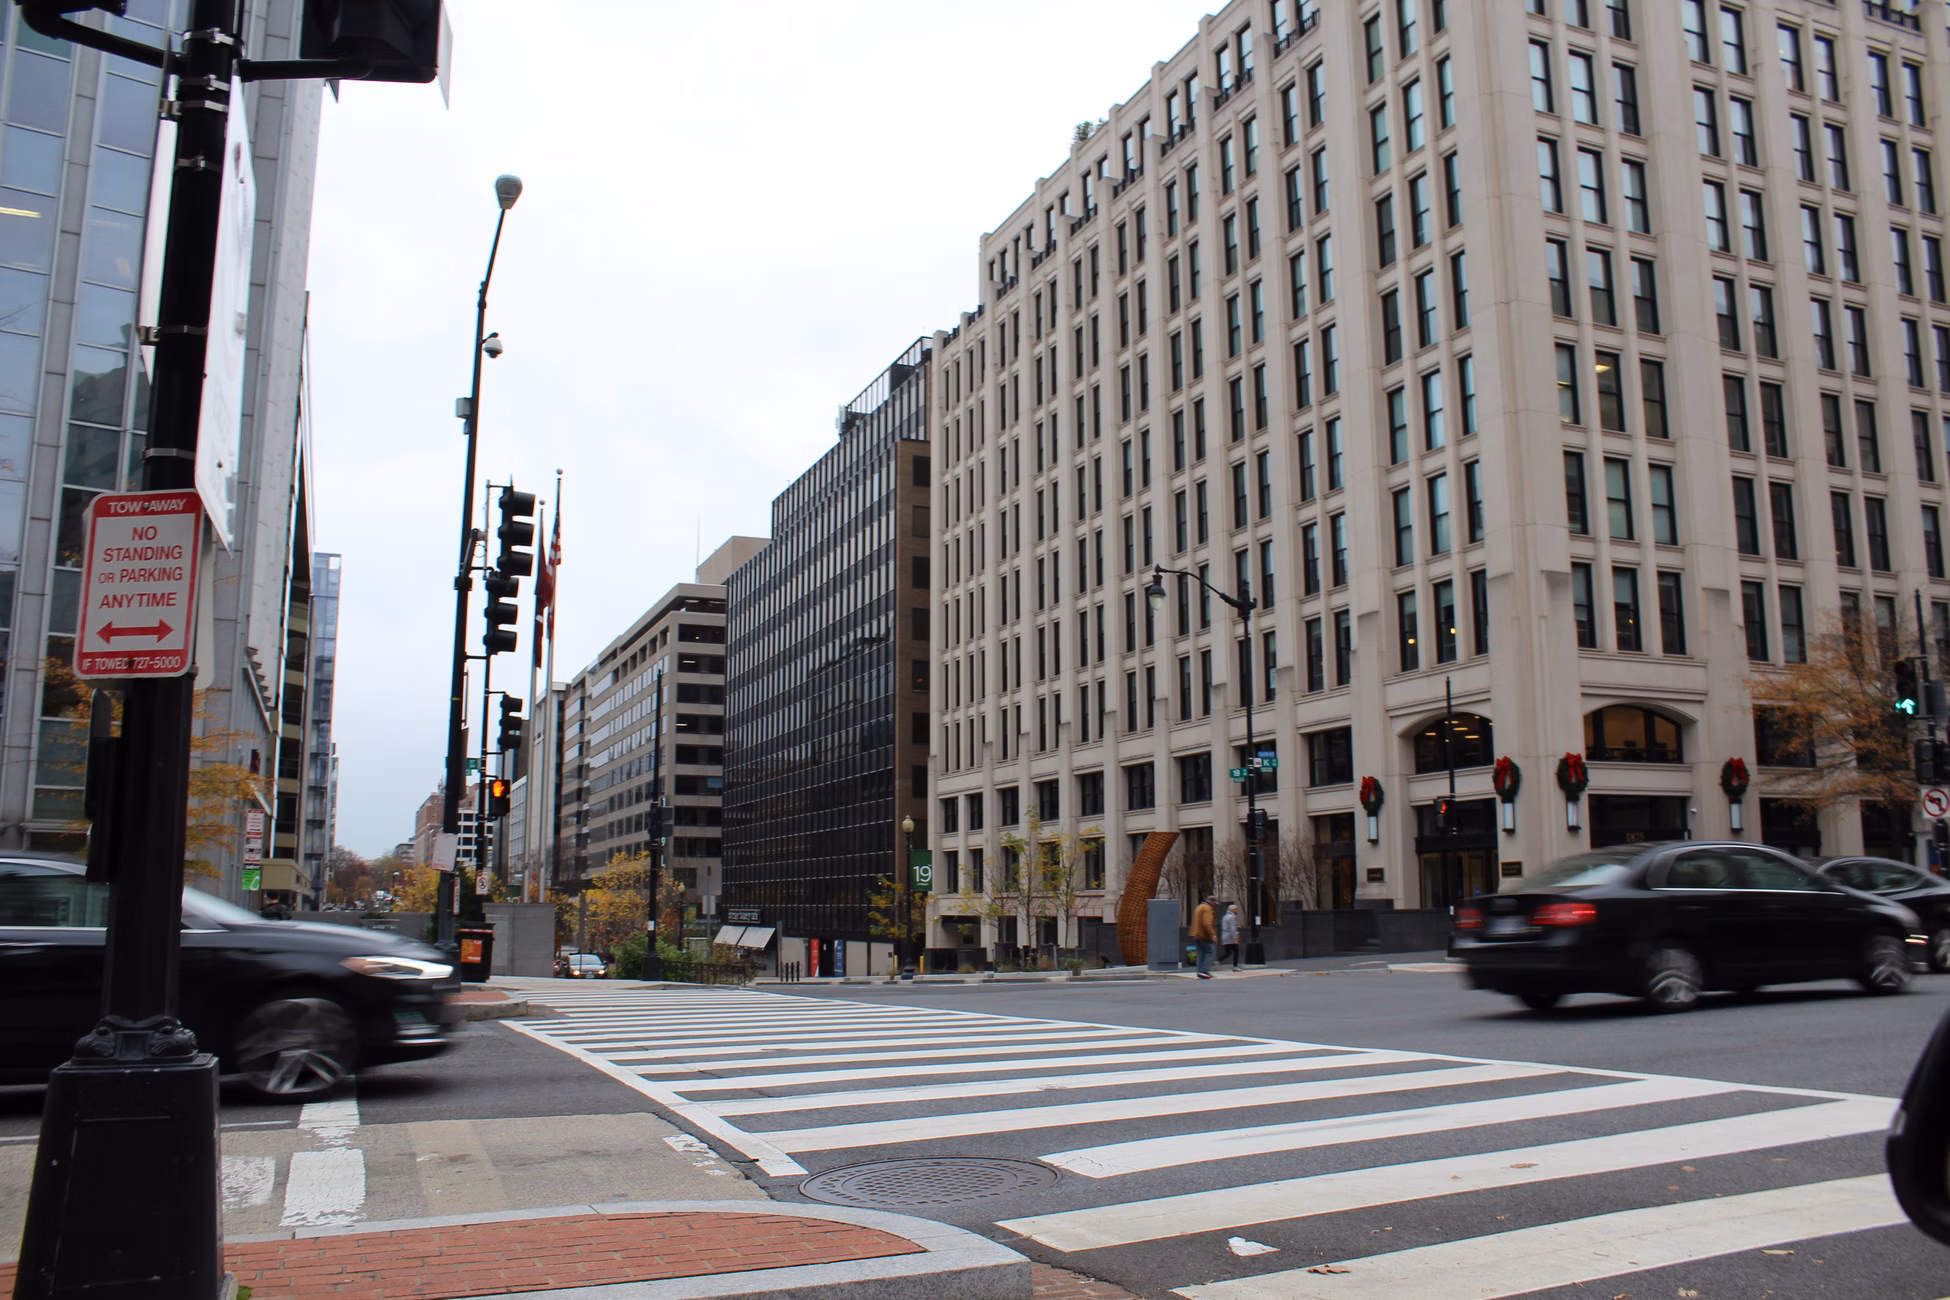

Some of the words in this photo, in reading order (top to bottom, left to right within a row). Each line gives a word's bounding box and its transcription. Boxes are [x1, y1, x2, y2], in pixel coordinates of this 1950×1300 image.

[108, 501, 143, 513] TOW
[147, 498, 187, 512] AWAY
[131, 526, 158, 541] NO
[103, 545, 183, 562] STANDING
[98, 572, 116, 584] OR
[119, 566, 183, 583] PARKING
[99, 592, 177, 609] ANYTIME
[82, 659, 93, 670] IF
[95, 657, 129, 670] TOWED
[133, 656, 182, 669] 727-5000
[1263, 759, 1270, 767] K
[1232, 769, 1241, 777] 19
[913, 865, 932, 882] 19
